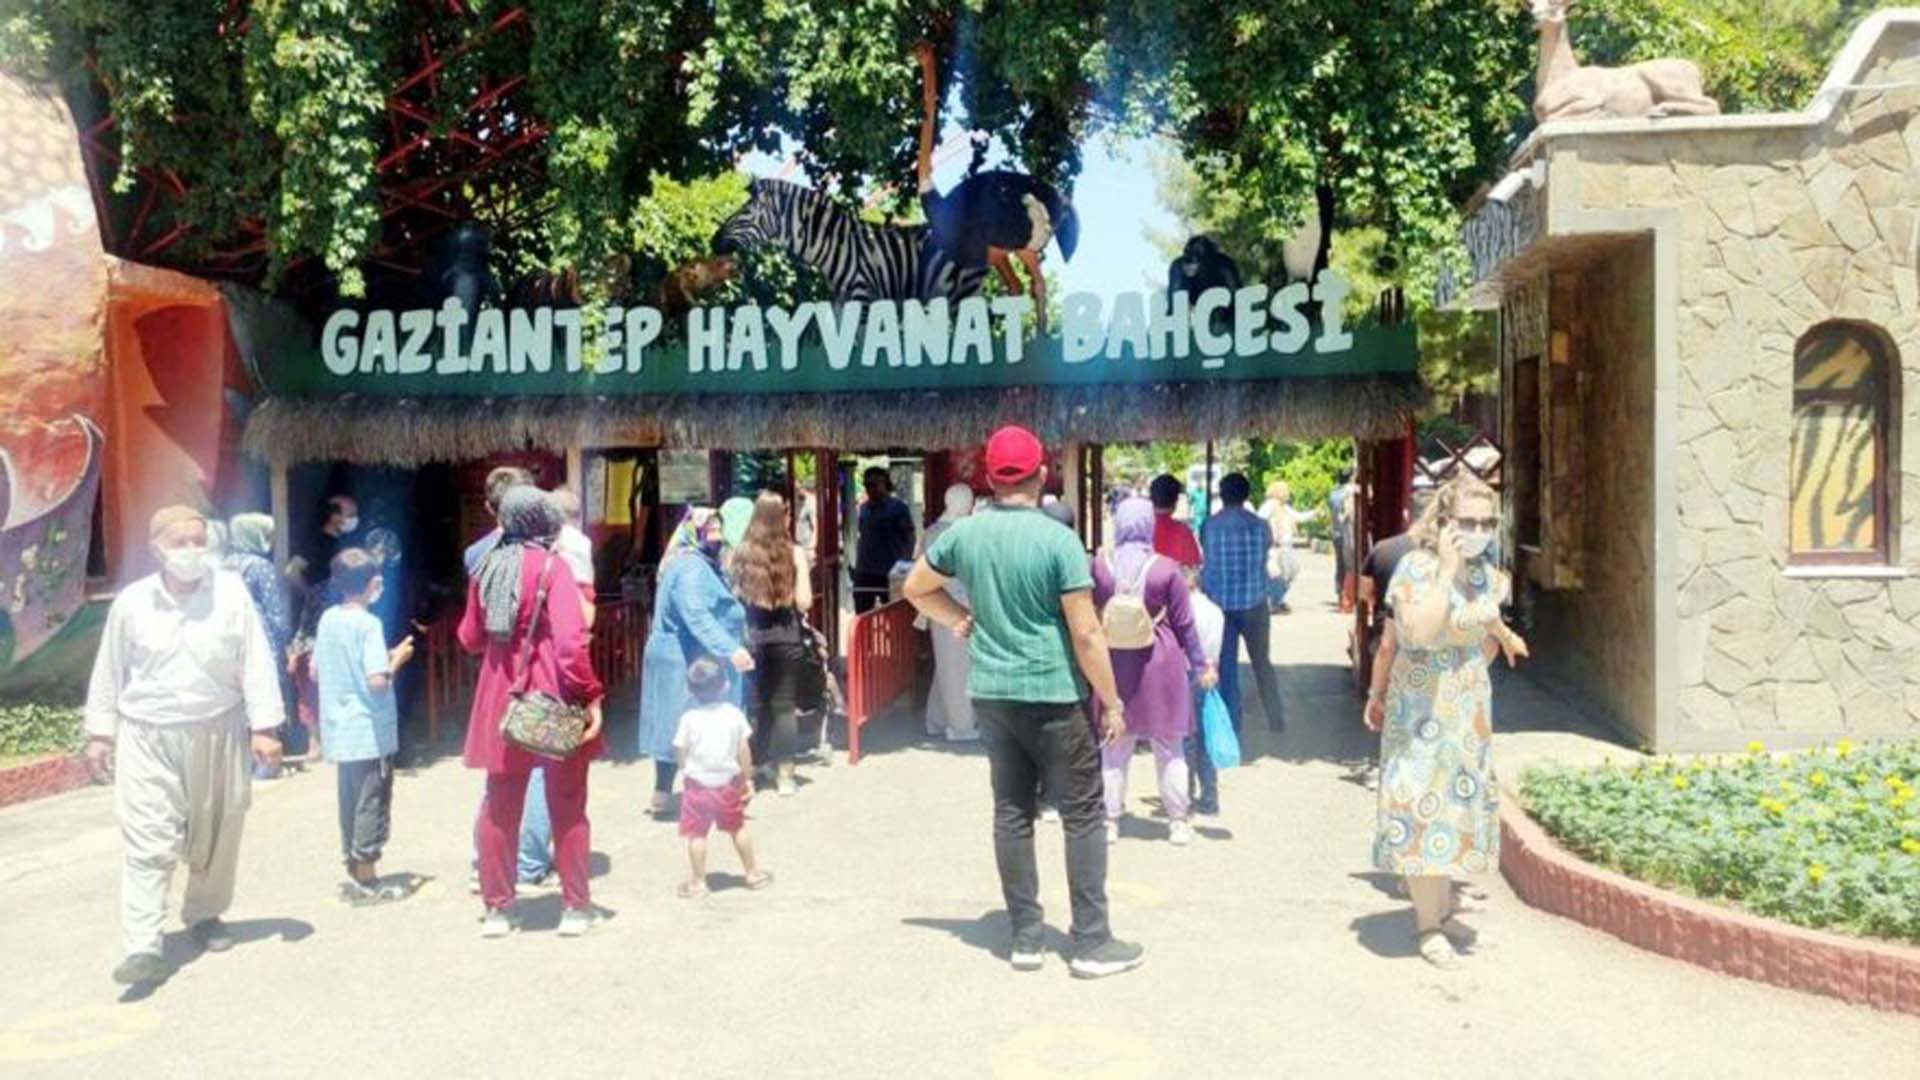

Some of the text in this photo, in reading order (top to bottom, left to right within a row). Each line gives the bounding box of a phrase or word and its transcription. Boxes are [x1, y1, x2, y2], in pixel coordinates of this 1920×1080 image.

[321, 269, 1354, 376] GAZİANTEP HAYVANAT BAHÇESİ
